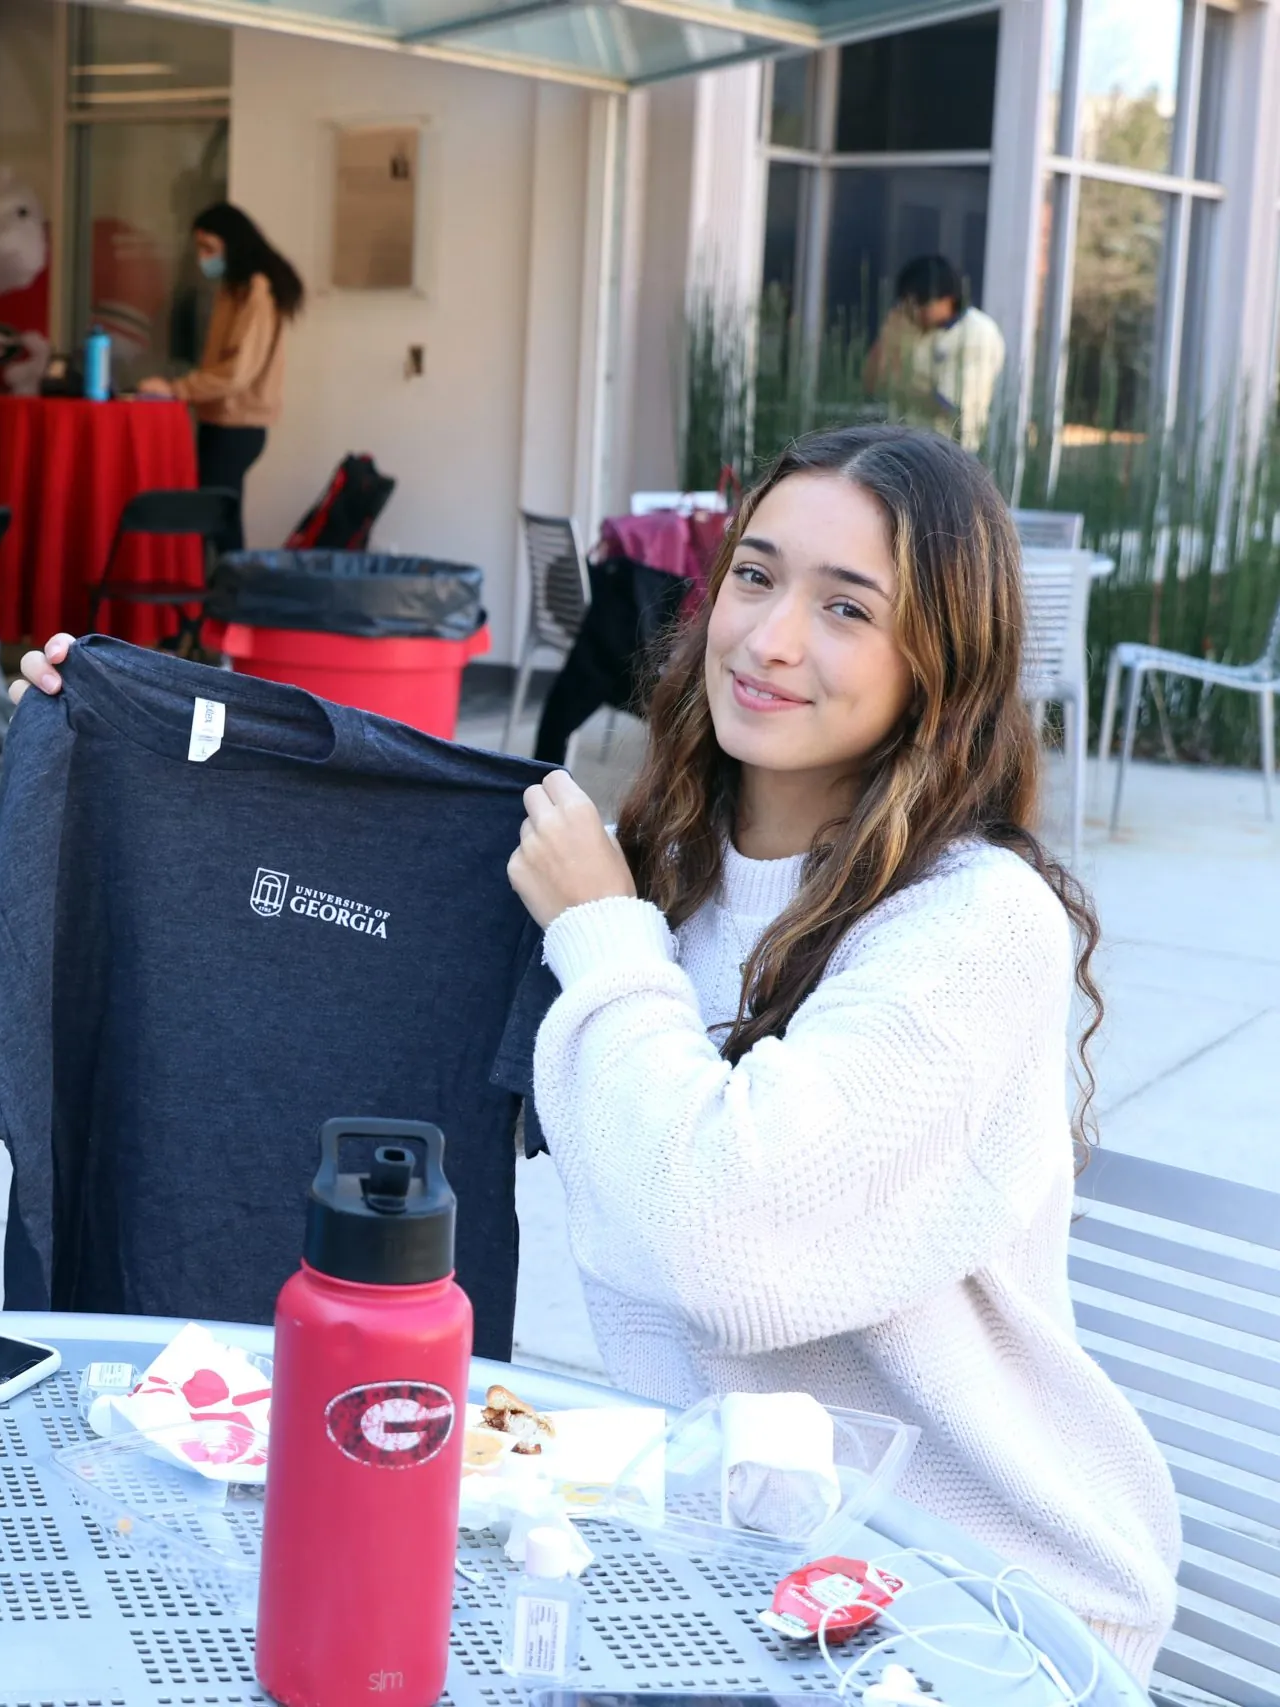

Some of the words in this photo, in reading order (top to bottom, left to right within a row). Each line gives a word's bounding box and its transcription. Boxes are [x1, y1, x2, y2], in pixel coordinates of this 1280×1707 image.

[289, 896, 388, 939] GEORGIA
[295, 885, 372, 915] UNIVERSITY
[374, 909, 391, 920] OF
